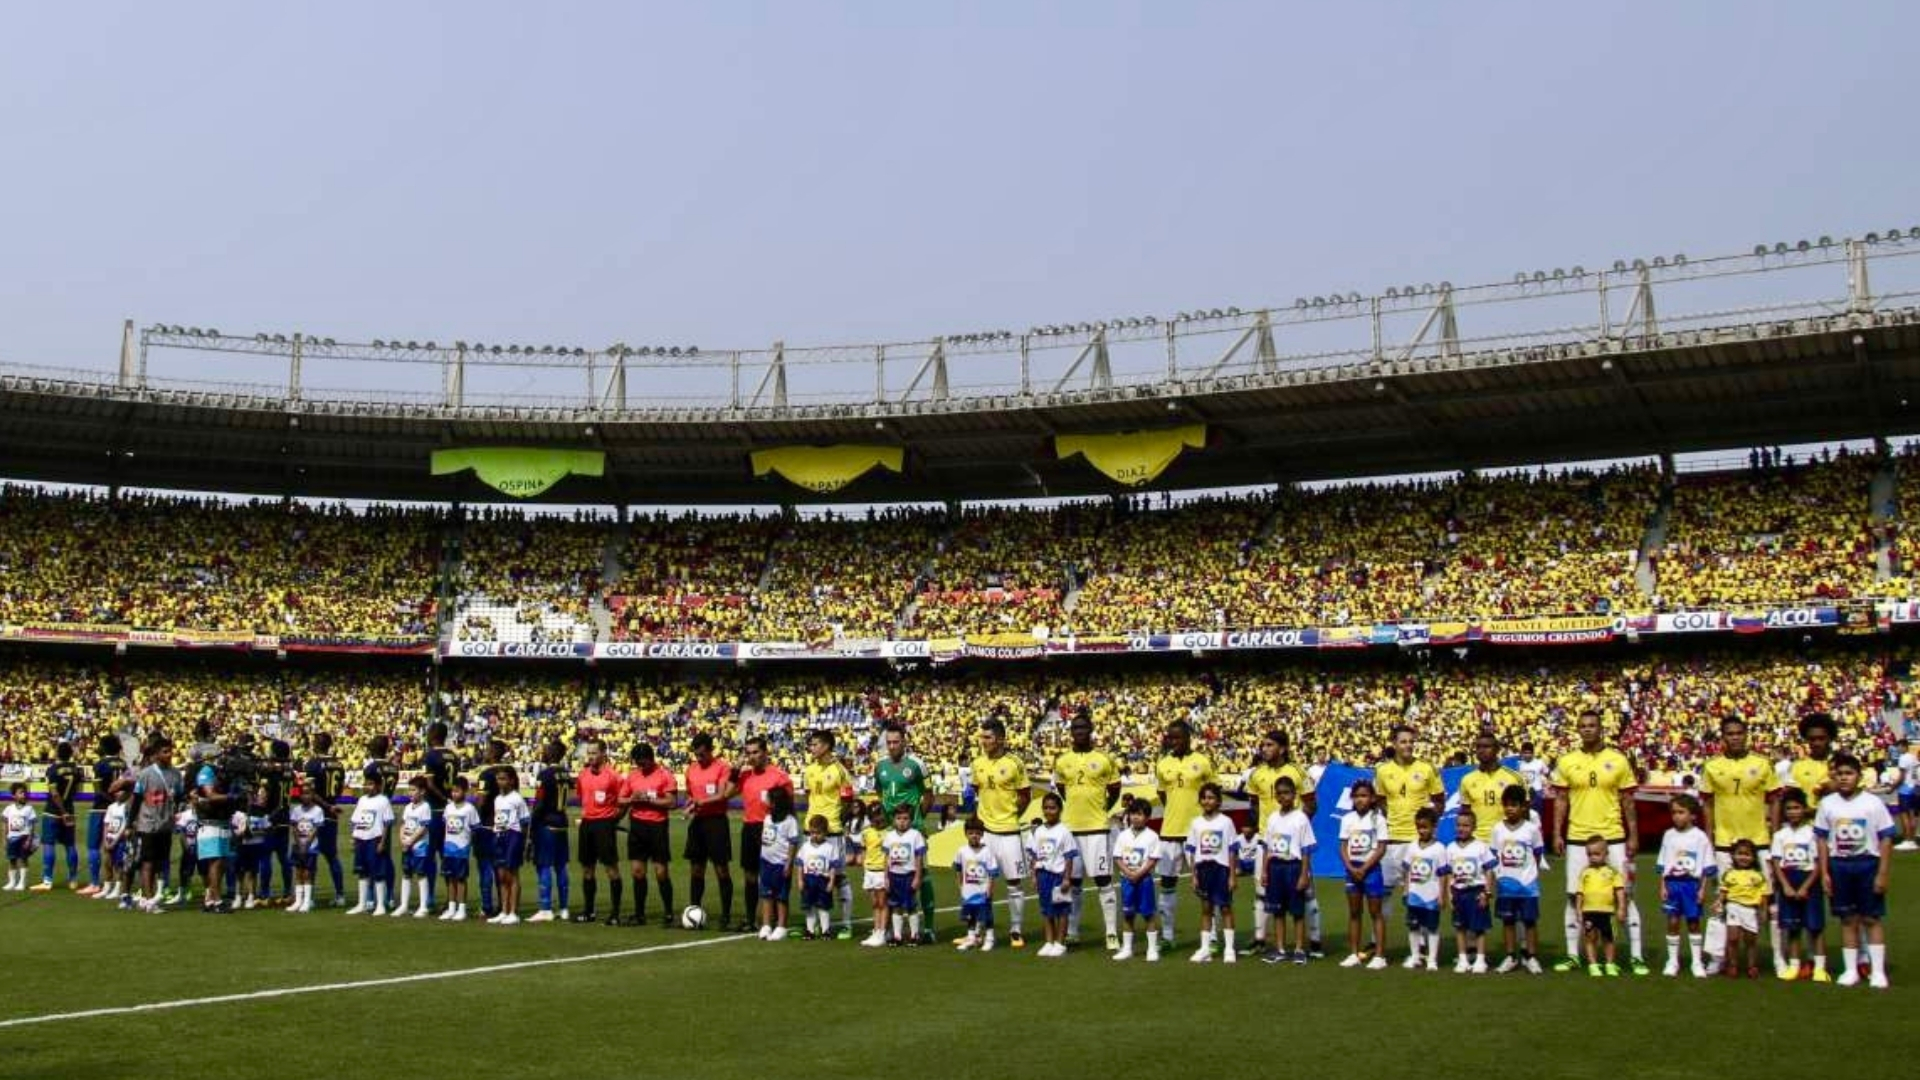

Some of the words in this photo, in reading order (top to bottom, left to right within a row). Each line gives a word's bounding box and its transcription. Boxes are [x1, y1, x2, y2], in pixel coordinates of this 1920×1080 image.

[1115, 466, 1147, 479] DIAZ
[499, 479, 545, 491] OSPINA
[1672, 613, 1715, 629] GOL
[1183, 634, 1218, 648] GOL
[1226, 631, 1304, 647] CARACOL
[1490, 632, 1546, 643] SEGUIMOS
[1548, 630, 1607, 642] CREYENDO
[461, 642, 495, 655] GOL
[503, 642, 577, 656] CARACOL
[606, 644, 640, 656] GOL
[648, 643, 719, 657] CARACOL
[893, 642, 926, 655] GOL
[1077, 770, 1085, 785] 2
[1589, 771, 1597, 788] 8
[63, 775, 74, 800] 7
[1399, 783, 1406, 798] 4
[1733, 779, 1741, 796] 7
[1483, 790, 1495, 806] 19
[1098, 856, 1105, 871] 2
